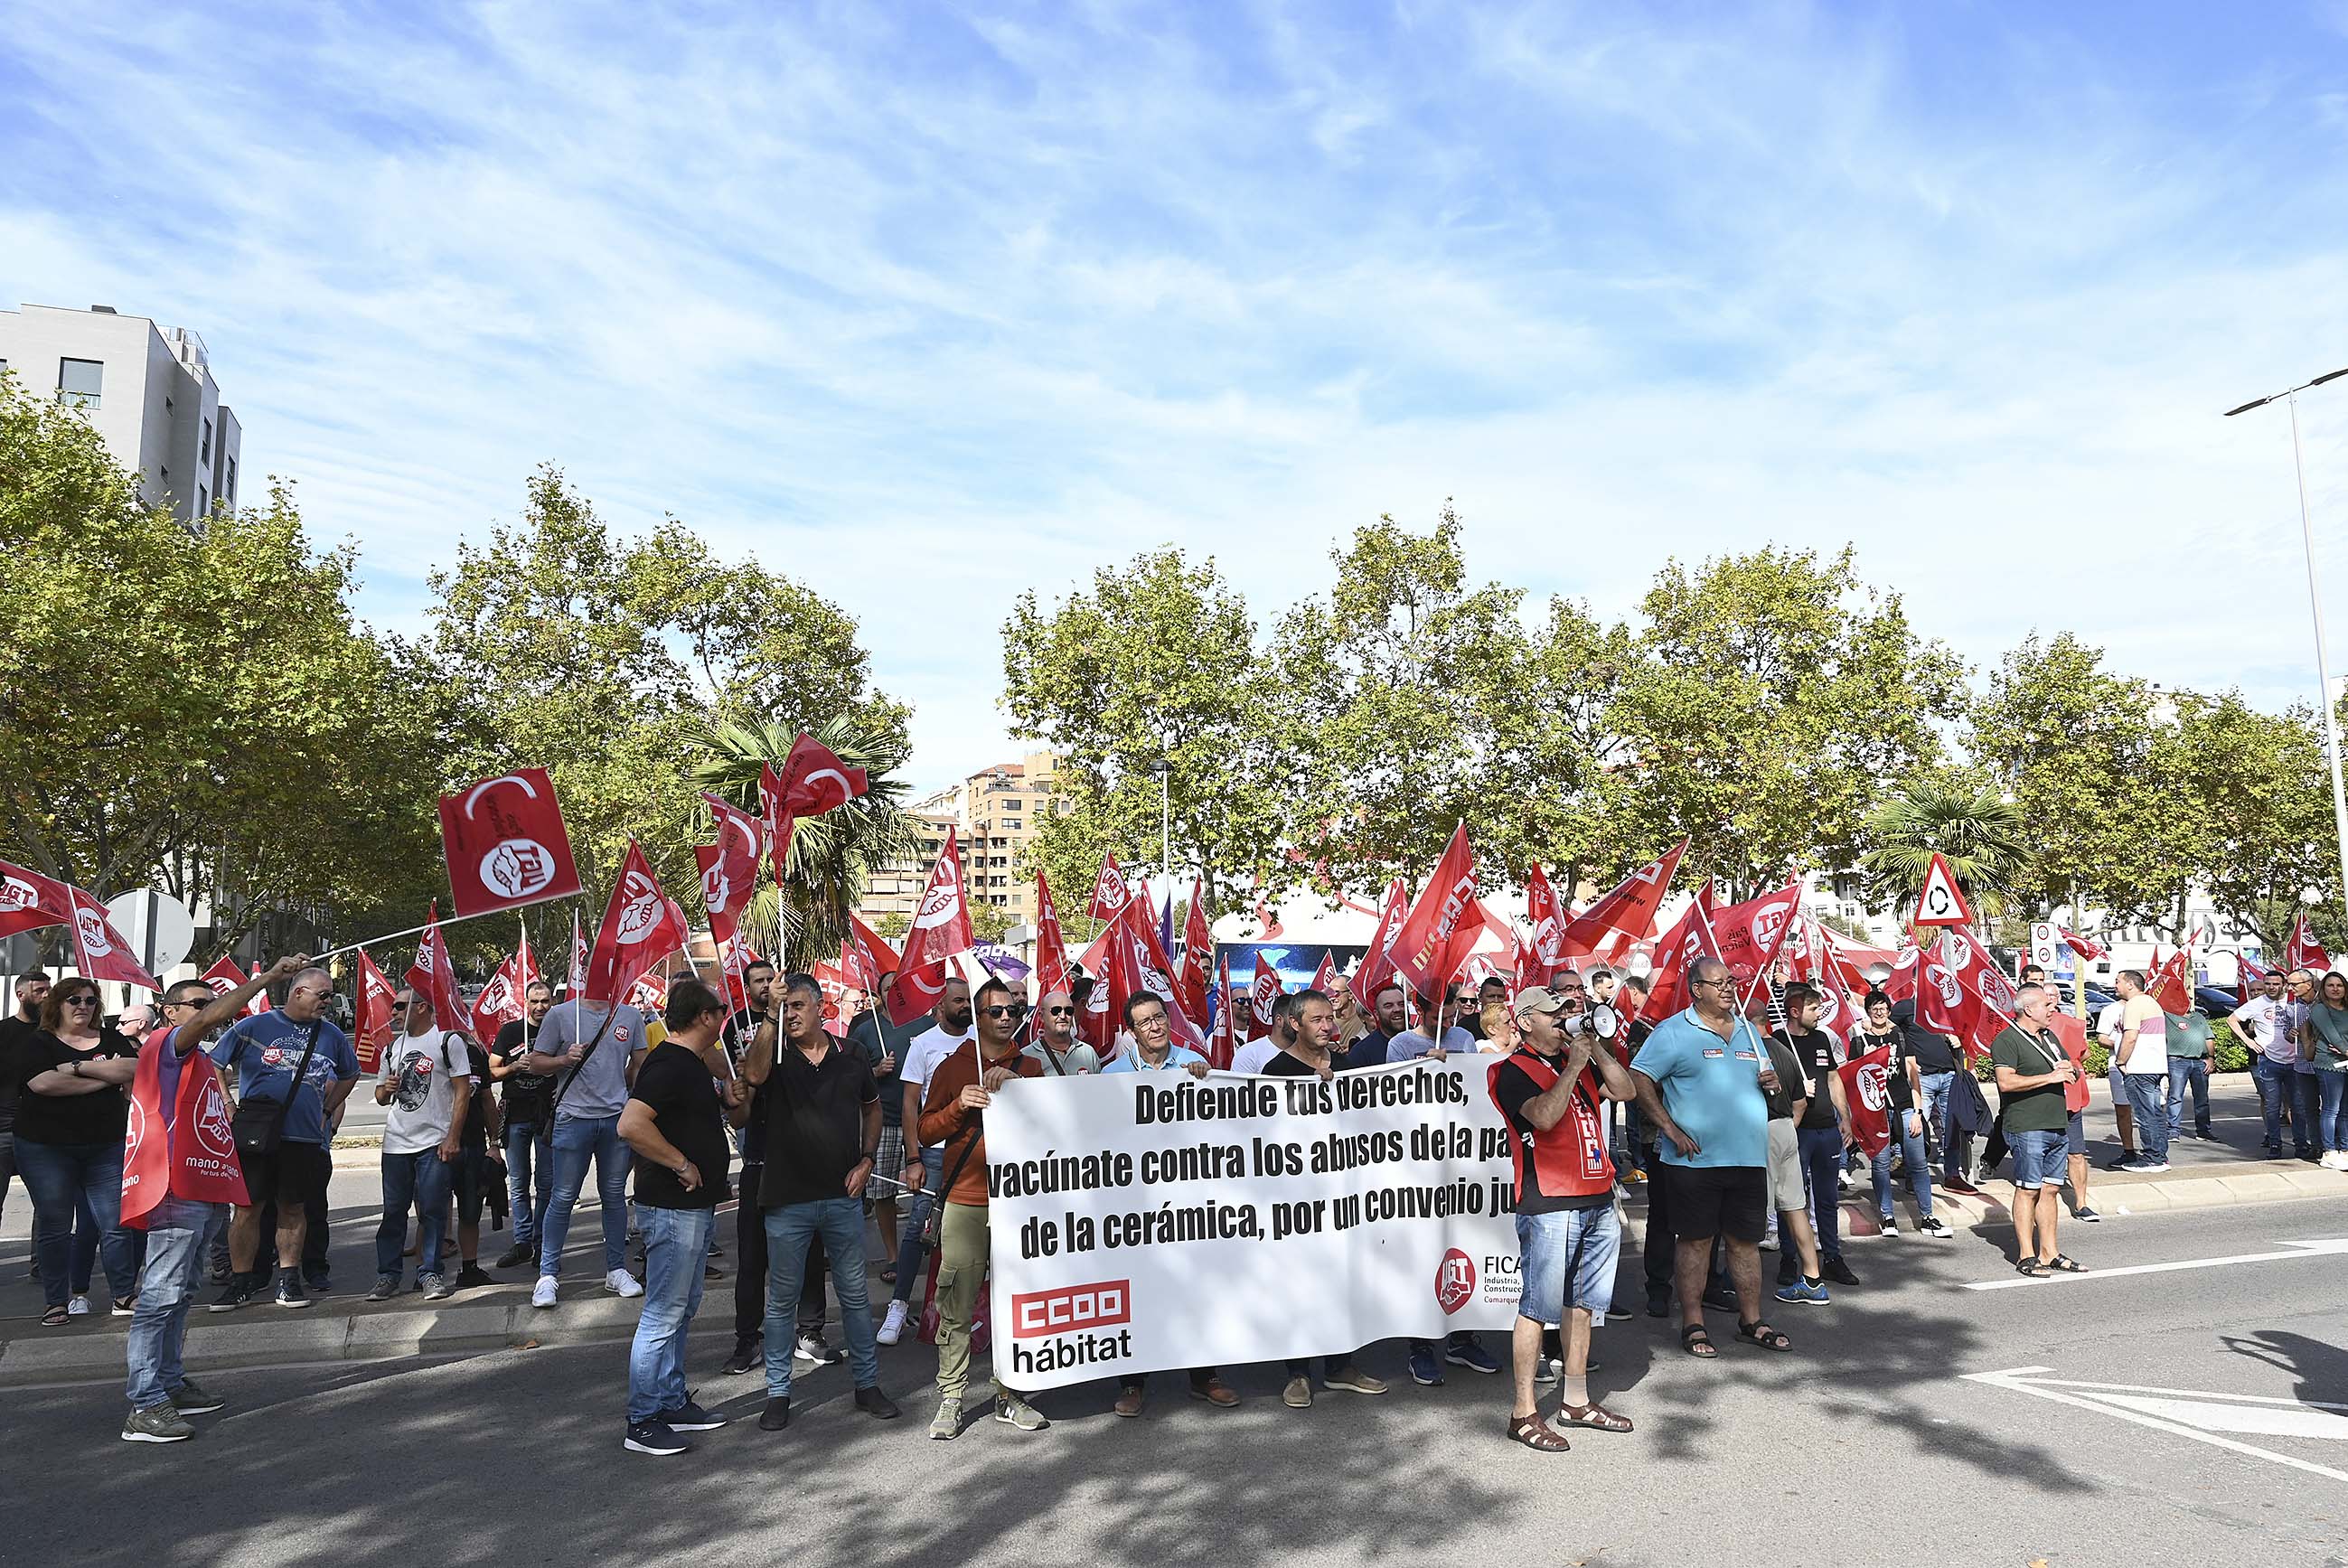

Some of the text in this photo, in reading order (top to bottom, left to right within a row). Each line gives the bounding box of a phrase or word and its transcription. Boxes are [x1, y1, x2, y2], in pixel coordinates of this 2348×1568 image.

[1136, 1067, 1469, 1124] Defiende tus derechos,
[186, 1157, 220, 1169] mano
[986, 1150, 1132, 1198] vacúnate
[1141, 1142, 1245, 1185] contra
[1252, 1137, 1303, 1177] los
[1310, 1129, 1403, 1174] abusos
[1021, 1216, 1058, 1259] de
[1066, 1212, 1095, 1253] la
[1103, 1199, 1265, 1250] cerámica,
[1273, 1198, 1326, 1241] por
[1333, 1191, 1360, 1231] un
[1365, 1177, 1484, 1223] convenio
[1442, 1257, 1469, 1283] UGT
[1020, 1288, 1122, 1330] CCOO
[1012, 1329, 1132, 1374] hábitat
